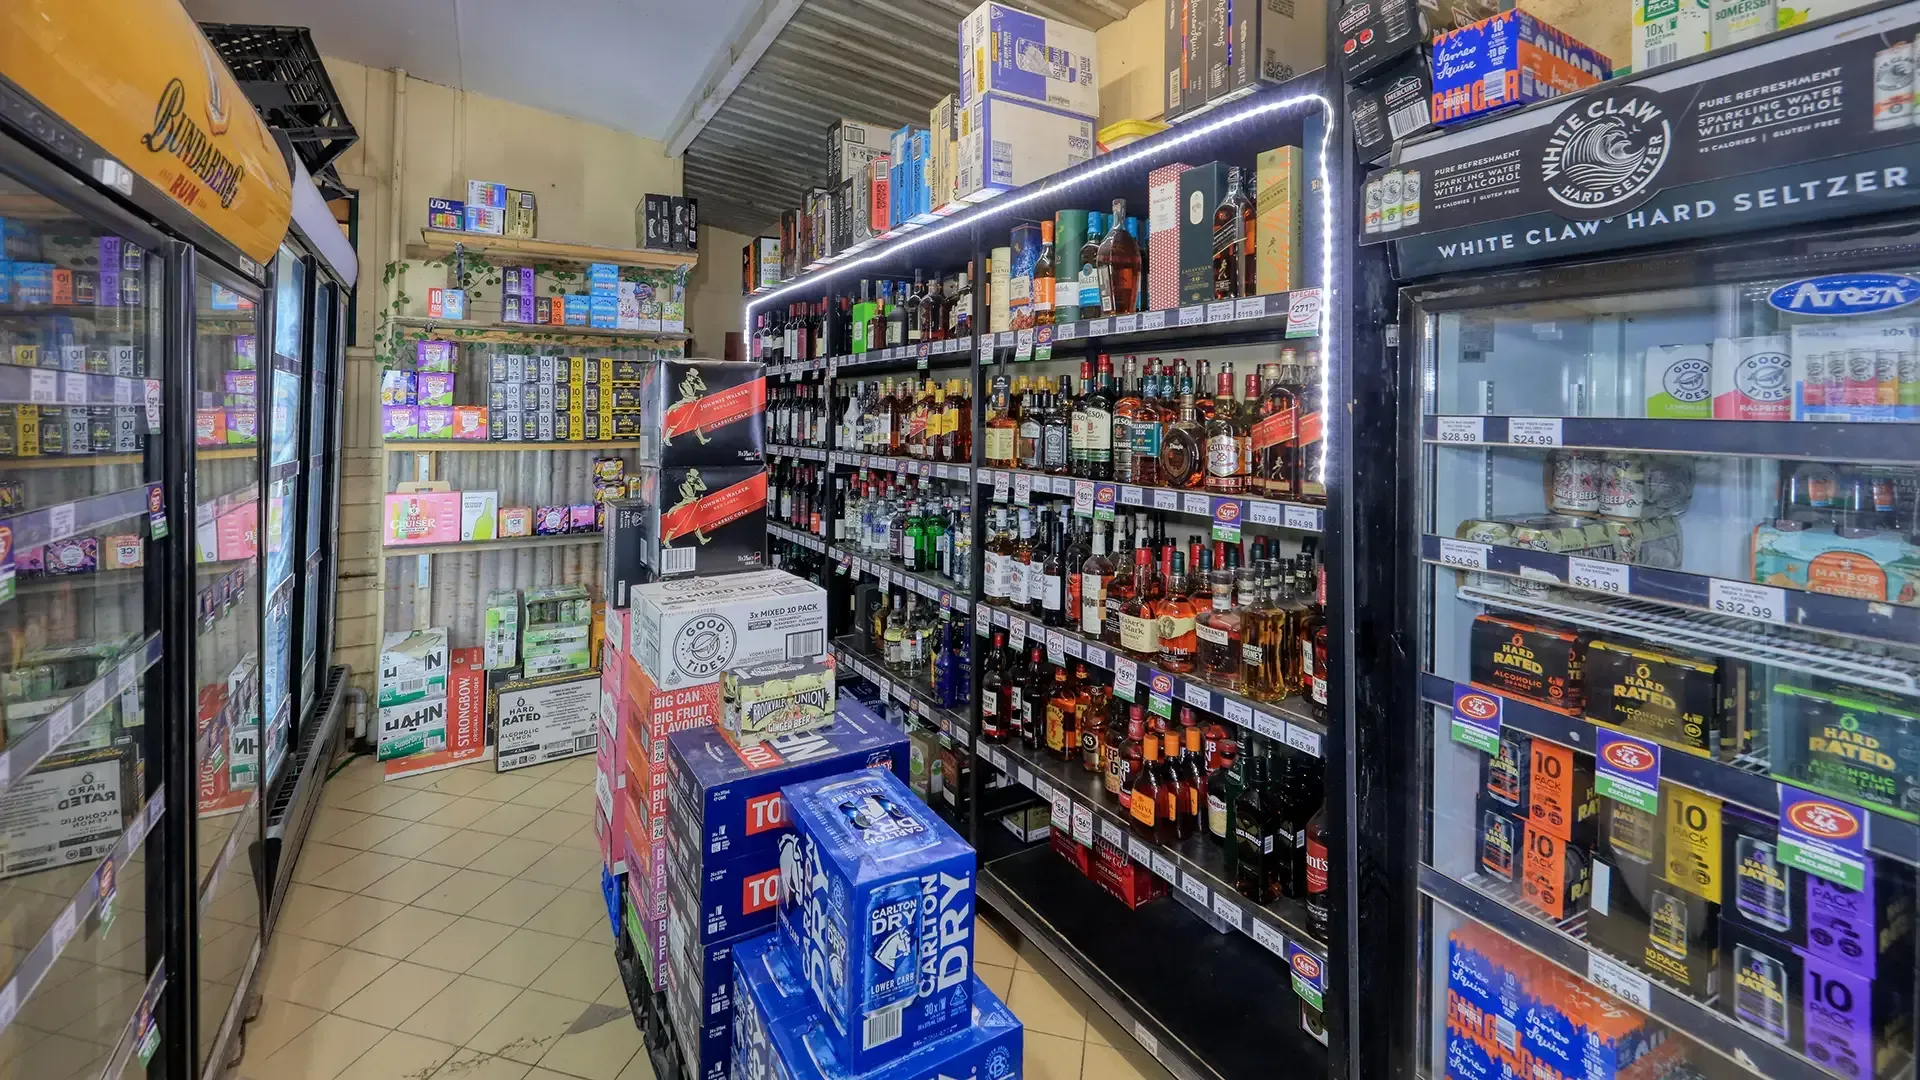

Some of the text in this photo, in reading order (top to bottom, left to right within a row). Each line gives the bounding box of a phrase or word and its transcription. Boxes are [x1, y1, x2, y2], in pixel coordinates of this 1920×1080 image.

[1341, 8, 1368, 27] MERCURY
[1491, 20, 1503, 32] 10
[1645, 23, 1664, 37] 10x
[1437, 44, 1477, 67] James
[1437, 59, 1477, 80] Squire
[1388, 81, 1418, 102] MERCURY
[1699, 67, 1842, 110] PURE REFRESHMENT
[1698, 85, 1843, 127] SPARKLING WATER
[1699, 97, 1843, 137] WITH ALCOHOL
[1542, 97, 1662, 182] WHITE CLAW
[1711, 136, 1757, 152] CALORIES
[1773, 125, 1812, 138] GLUTEN
[1814, 118, 1841, 129] FREE
[1435, 149, 1520, 176] PURE REFRESHMENT
[1562, 134, 1663, 204] HARD SELTZER
[1434, 164, 1521, 190] SPARKLING WATER
[1434, 172, 1521, 197] WITH ALCOHOL
[170, 173, 200, 207] RUM
[1442, 198, 1470, 209] CALORIES
[1504, 188, 1520, 196] FREE
[430, 200, 452, 210] UDL
[1438, 234, 1514, 259] WHITE
[1627, 200, 1716, 229] HARD
[1733, 166, 1908, 213] SELTZER
[431, 290, 441, 304] 10
[522, 298, 531, 307] 10
[1290, 289, 1320, 298] SPECIAL
[1210, 313, 1231, 322] $71.99
[1674, 362, 1709, 373] GOOD
[1748, 356, 1791, 369] GOOD
[700, 396, 725, 411] JOHNNIE
[710, 412, 748, 429] CLASSIC COLA
[1442, 432, 1476, 443] $28.99
[1513, 434, 1553, 446] $24.99
[700, 495, 725, 511] JOHNNIE
[1580, 491, 1598, 500] BEER
[1605, 495, 1624, 504] BEER
[390, 518, 436, 529] CRUISER
[710, 509, 748, 528] CLASSIC COLA
[1253, 513, 1276, 524] $79.99
[1288, 518, 1313, 529] $94.99
[1445, 554, 1479, 568] $34.99
[1575, 576, 1619, 592] $31.99
[1815, 569, 1879, 585] MATSO'S
[687, 588, 734, 598] MIXED
[759, 580, 793, 589] PACK
[760, 608, 785, 618] MIXED
[798, 603, 818, 611] PACK
[1716, 600, 1772, 619] $32.99
[686, 620, 725, 637] GOOD
[1125, 624, 1144, 635] Mark
[1243, 649, 1263, 660] HONEY
[1503, 644, 1534, 658] HARD
[1493, 652, 1543, 676] RATED
[1494, 670, 1542, 689] ALCOHOLIC
[1504, 680, 1532, 690] ORANGE
[1624, 676, 1665, 692] HARD
[654, 691, 702, 710] BIG CAN.
[1614, 684, 1676, 709] RATED
[509, 706, 534, 715] HARD
[654, 704, 708, 725] BIG FRUIT
[753, 689, 825, 724] BROOKVALE UNION
[1614, 704, 1675, 725] ALCOHOLIC
[502, 713, 541, 727] RATED
[654, 716, 715, 738] FLAVOURS.
[768, 715, 811, 732] GINGER BEER
[1627, 713, 1664, 729] LEMON
[500, 728, 539, 740] ALCOHOLIC
[508, 734, 531, 742] LEMON
[1084, 737, 1094, 745] 43
[1824, 726, 1880, 750] HARD
[655, 752, 664, 760] 24
[1809, 737, 1896, 771] RATED
[1534, 750, 1561, 779] 10
[1810, 759, 1895, 787] ALCOHOLIC
[1534, 775, 1561, 791] PACK
[1608, 787, 1645, 806] EXCLUSIVE
[1673, 800, 1707, 831] 10
[654, 829, 663, 837] 24
[865, 826, 924, 846] CARLTON
[1672, 827, 1709, 845] PACK
[1528, 829, 1554, 859] 10
[1527, 852, 1555, 869] PACK
[1794, 854, 1847, 879] EXCLUSIVE
[657, 902, 666, 914] 24
[872, 900, 917, 920] CARLTON
[872, 909, 915, 935] DRY
[919, 873, 938, 998] CARLTON
[1452, 952, 1489, 984] James
[1656, 951, 1688, 974] PACK
[871, 972, 915, 995] LOWER CARB
[1452, 969, 1489, 999] Squire
[1504, 971, 1515, 985] 10
[1593, 973, 1640, 1004] $54.99
[1810, 970, 1852, 1012] 10
[1810, 1001, 1856, 1029] PACK
[1526, 1007, 1570, 1044] James
[1525, 1025, 1569, 1061] Squire
[1587, 1032, 1600, 1048] 10
[1450, 1039, 1487, 1075] James
